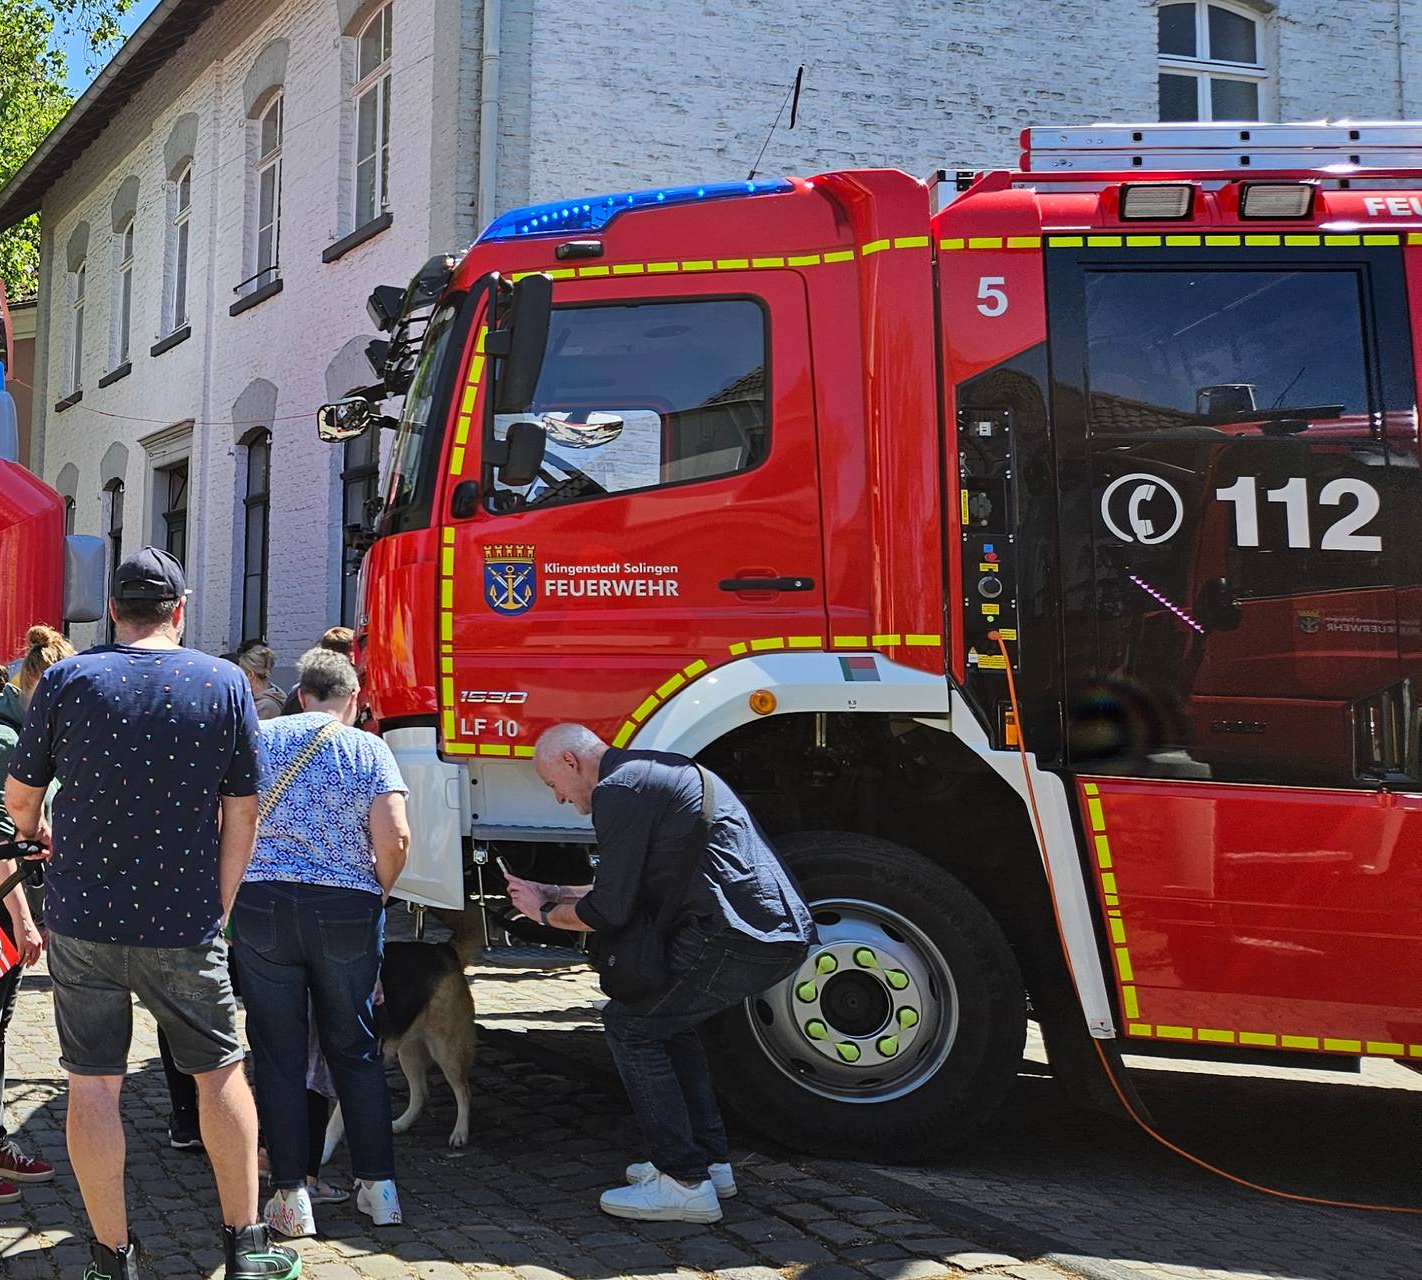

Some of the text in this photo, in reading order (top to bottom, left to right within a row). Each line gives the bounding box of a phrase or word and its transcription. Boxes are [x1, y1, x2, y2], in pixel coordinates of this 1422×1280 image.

[977, 276, 1008, 317] 5
[1216, 476, 1382, 551] 112
[544, 562, 678, 576] Klingenstadt Solingen
[545, 579, 679, 597] FEUERWEHR
[460, 690, 529, 704] 1530
[461, 718, 519, 738] LF 10
